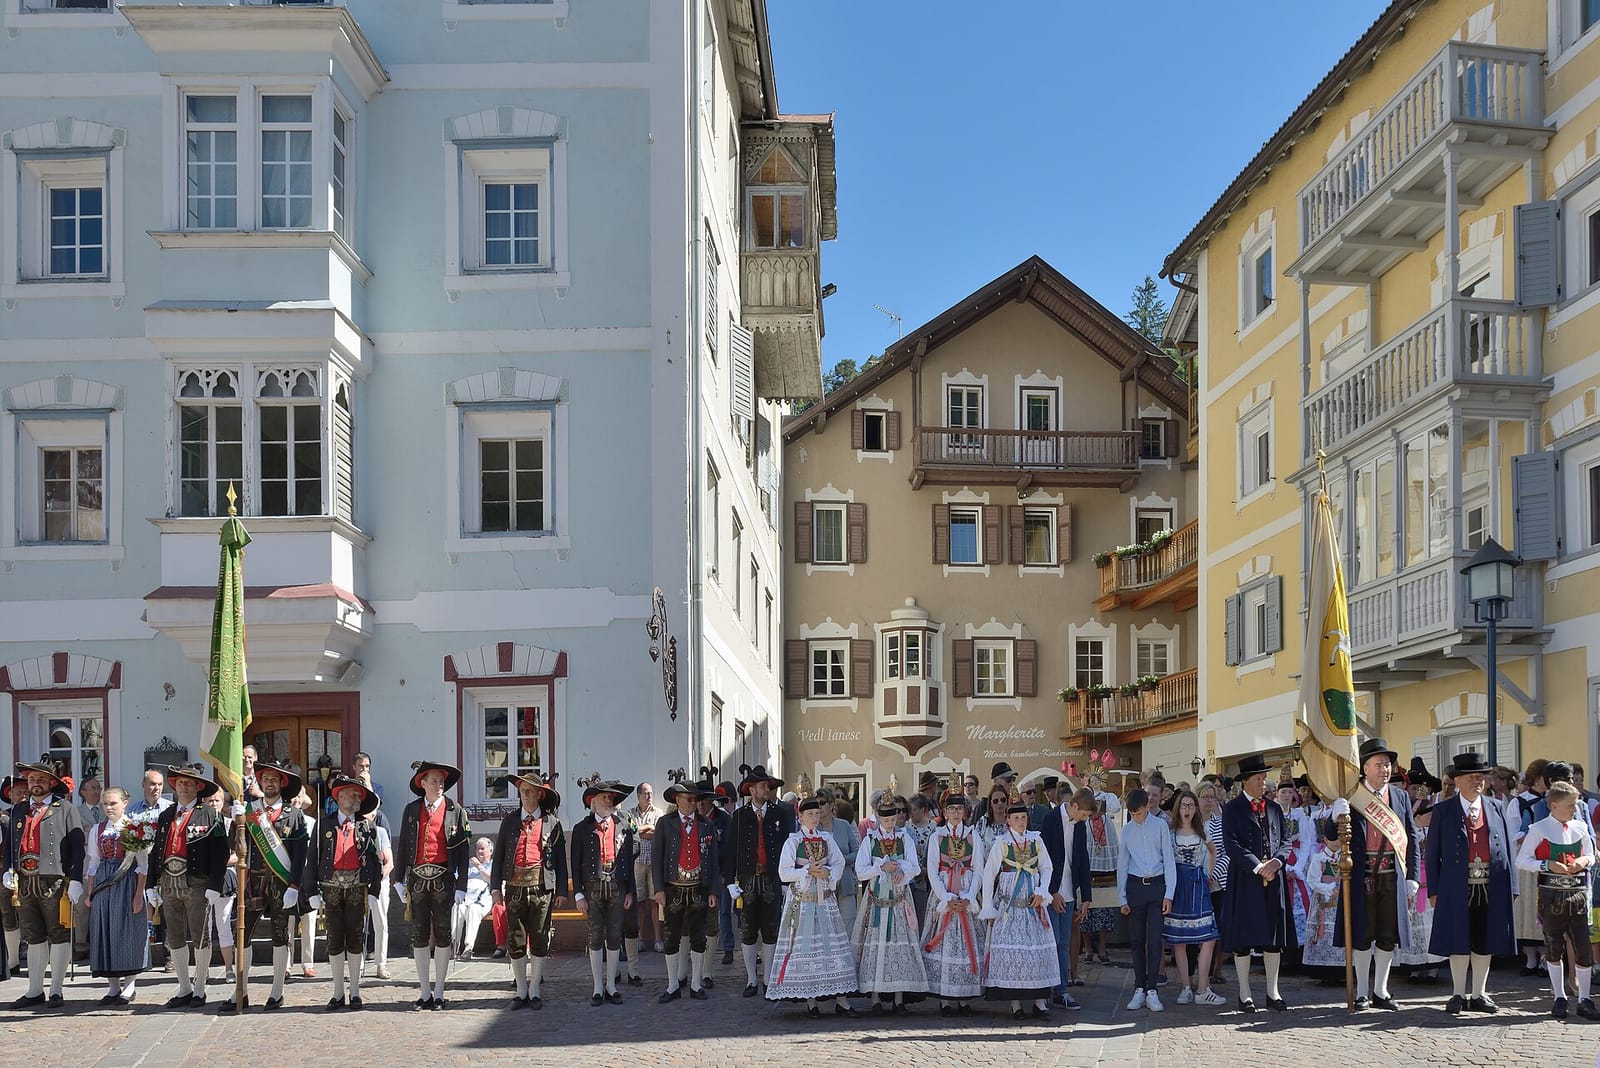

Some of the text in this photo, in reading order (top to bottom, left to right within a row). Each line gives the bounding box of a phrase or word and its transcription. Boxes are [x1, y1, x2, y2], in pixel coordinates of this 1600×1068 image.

[1385, 712, 1394, 722] 57
[798, 727, 825, 742] Vedl
[966, 724, 1046, 744] Margherita
[983, 749, 1008, 759] Moda
